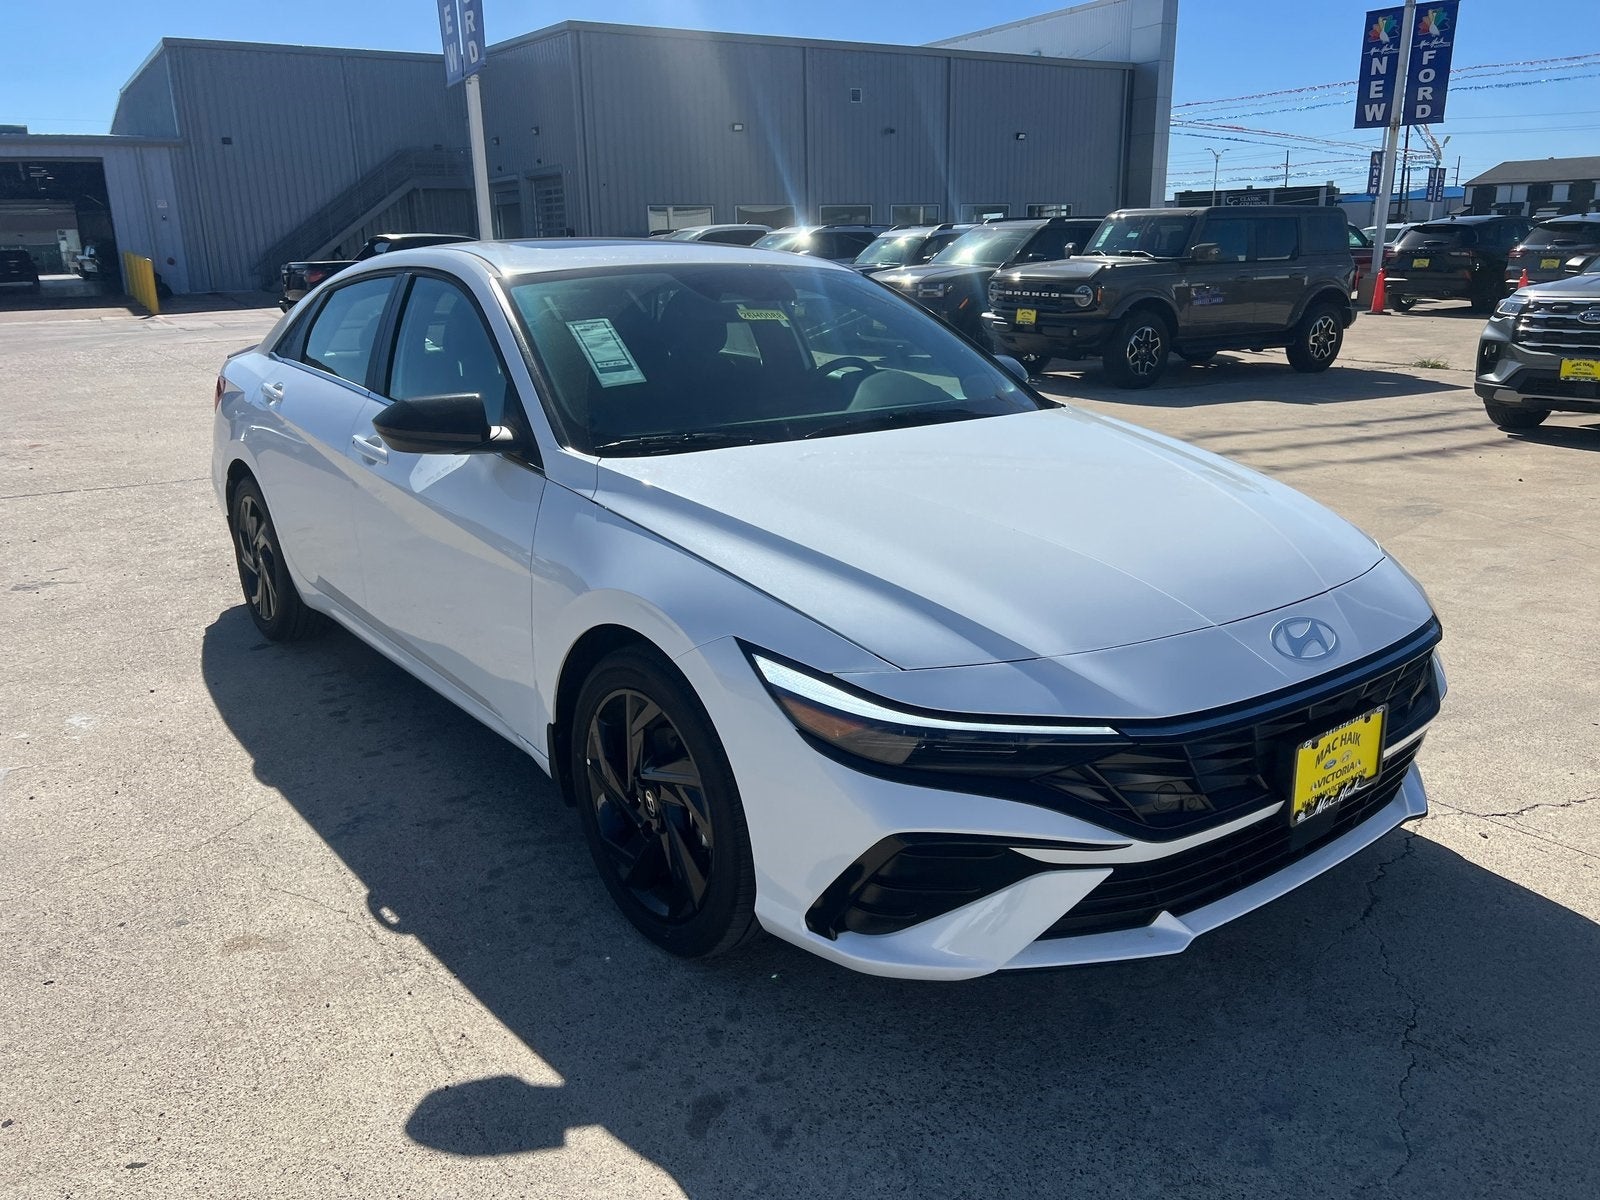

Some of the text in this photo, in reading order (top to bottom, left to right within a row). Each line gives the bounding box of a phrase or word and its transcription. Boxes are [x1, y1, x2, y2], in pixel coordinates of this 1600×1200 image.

[463, 0, 479, 64] RD
[1364, 56, 1388, 122] NEW
[1415, 50, 1437, 119] FORD
[1369, 168, 1380, 194] NEW
[1005, 290, 1060, 298] BRONCO
[1314, 737, 1339, 769] MAC
[1339, 731, 1361, 748] HAIK
[1317, 761, 1355, 788] VICTORIA
